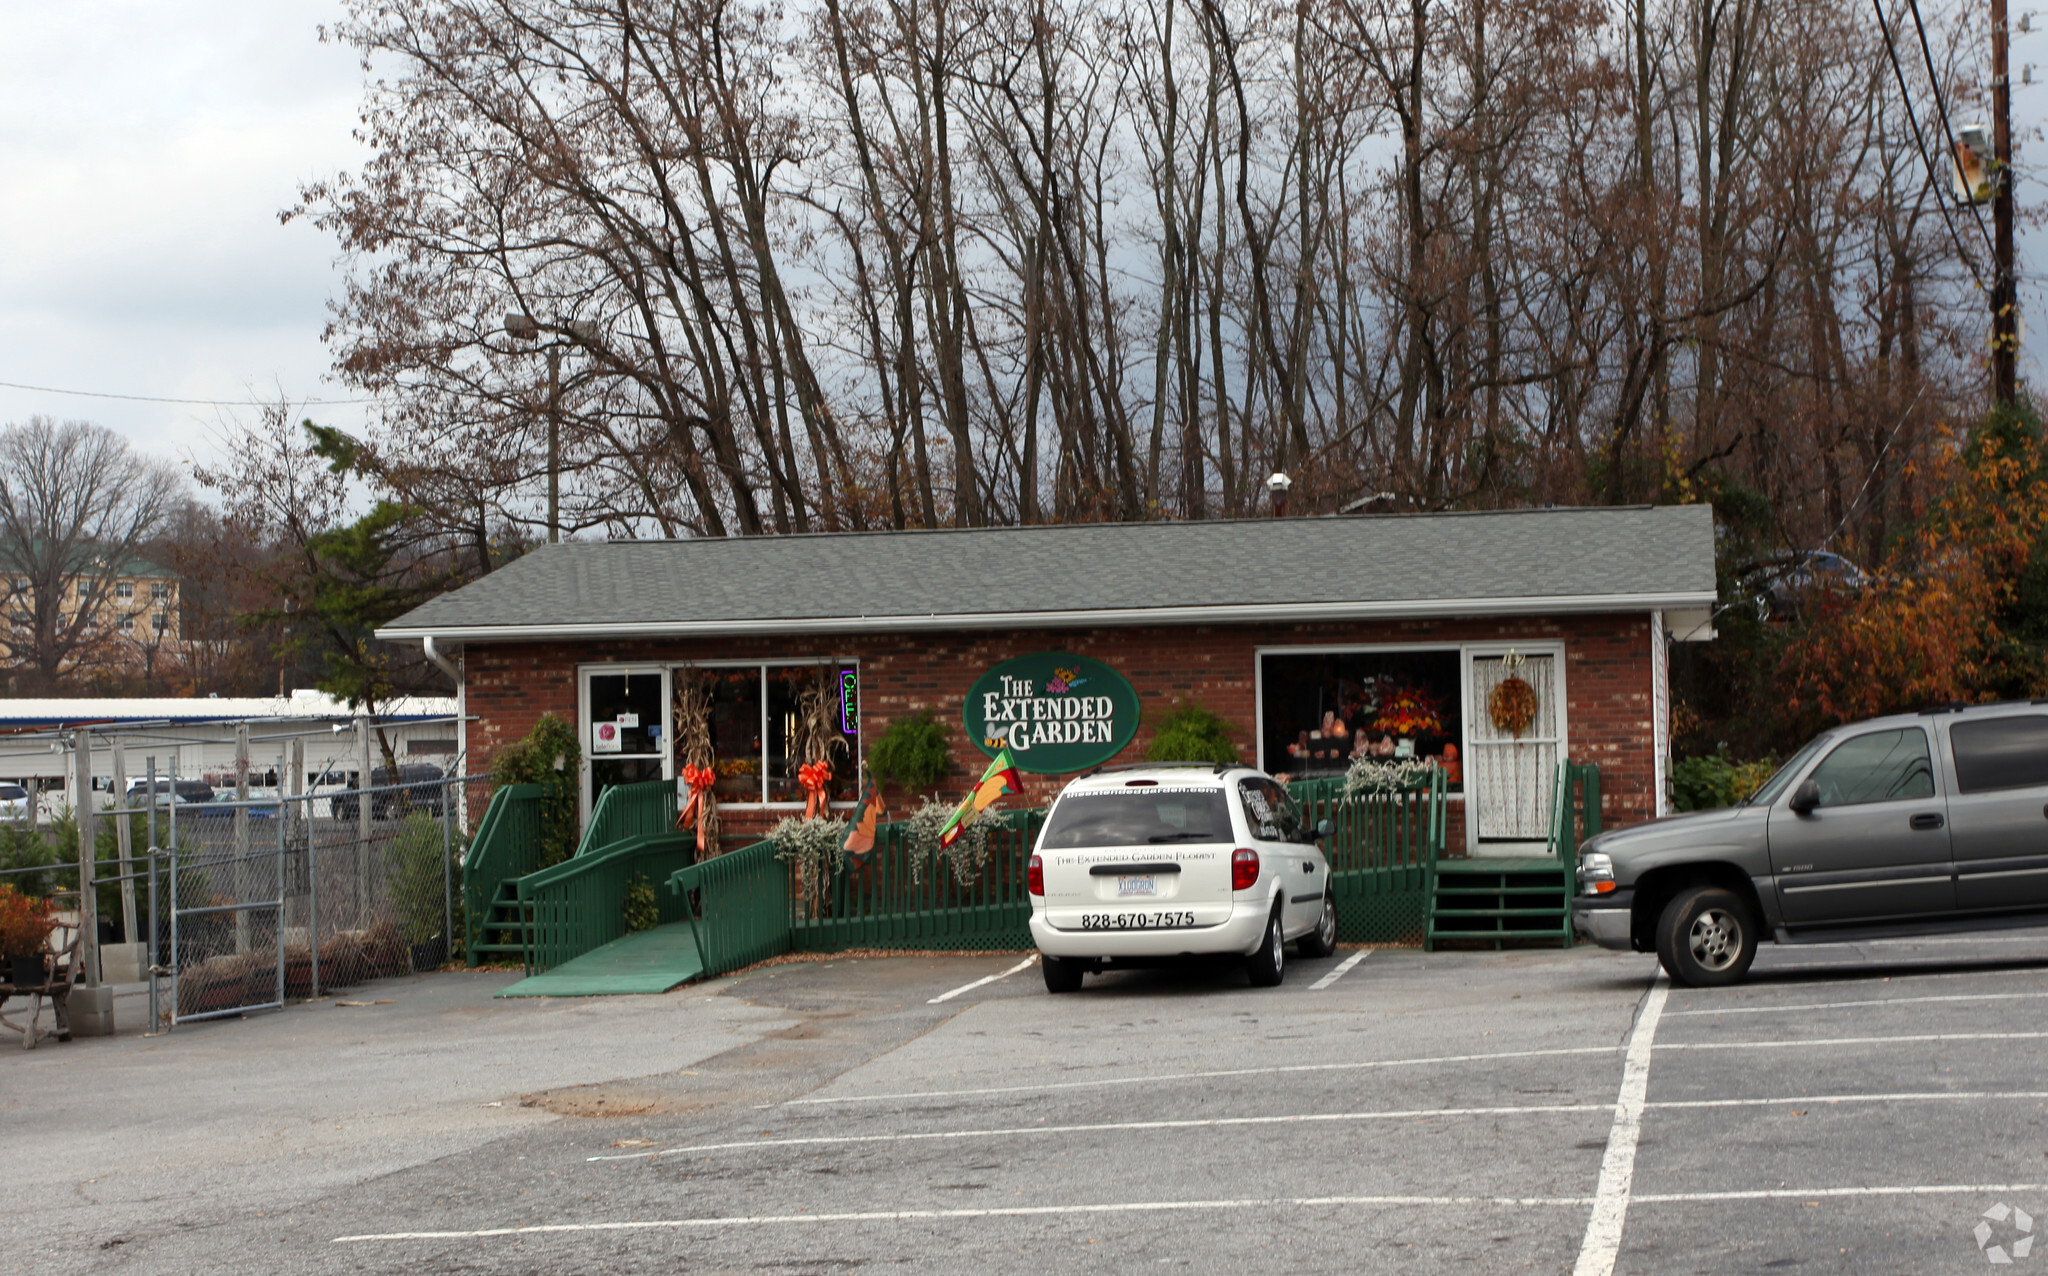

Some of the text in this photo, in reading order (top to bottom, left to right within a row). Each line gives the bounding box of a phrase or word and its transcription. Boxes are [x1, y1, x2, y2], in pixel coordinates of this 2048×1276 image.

[1000, 675, 1033, 698] THE
[983, 691, 1114, 722] EXTENDED
[1008, 719, 1114, 751] GARDEN
[1056, 856, 1073, 866] THE
[1077, 854, 1129, 865] EXTENDED
[1131, 852, 1173, 863] GARDEN
[1081, 911, 1195, 929] 828-670-7575
